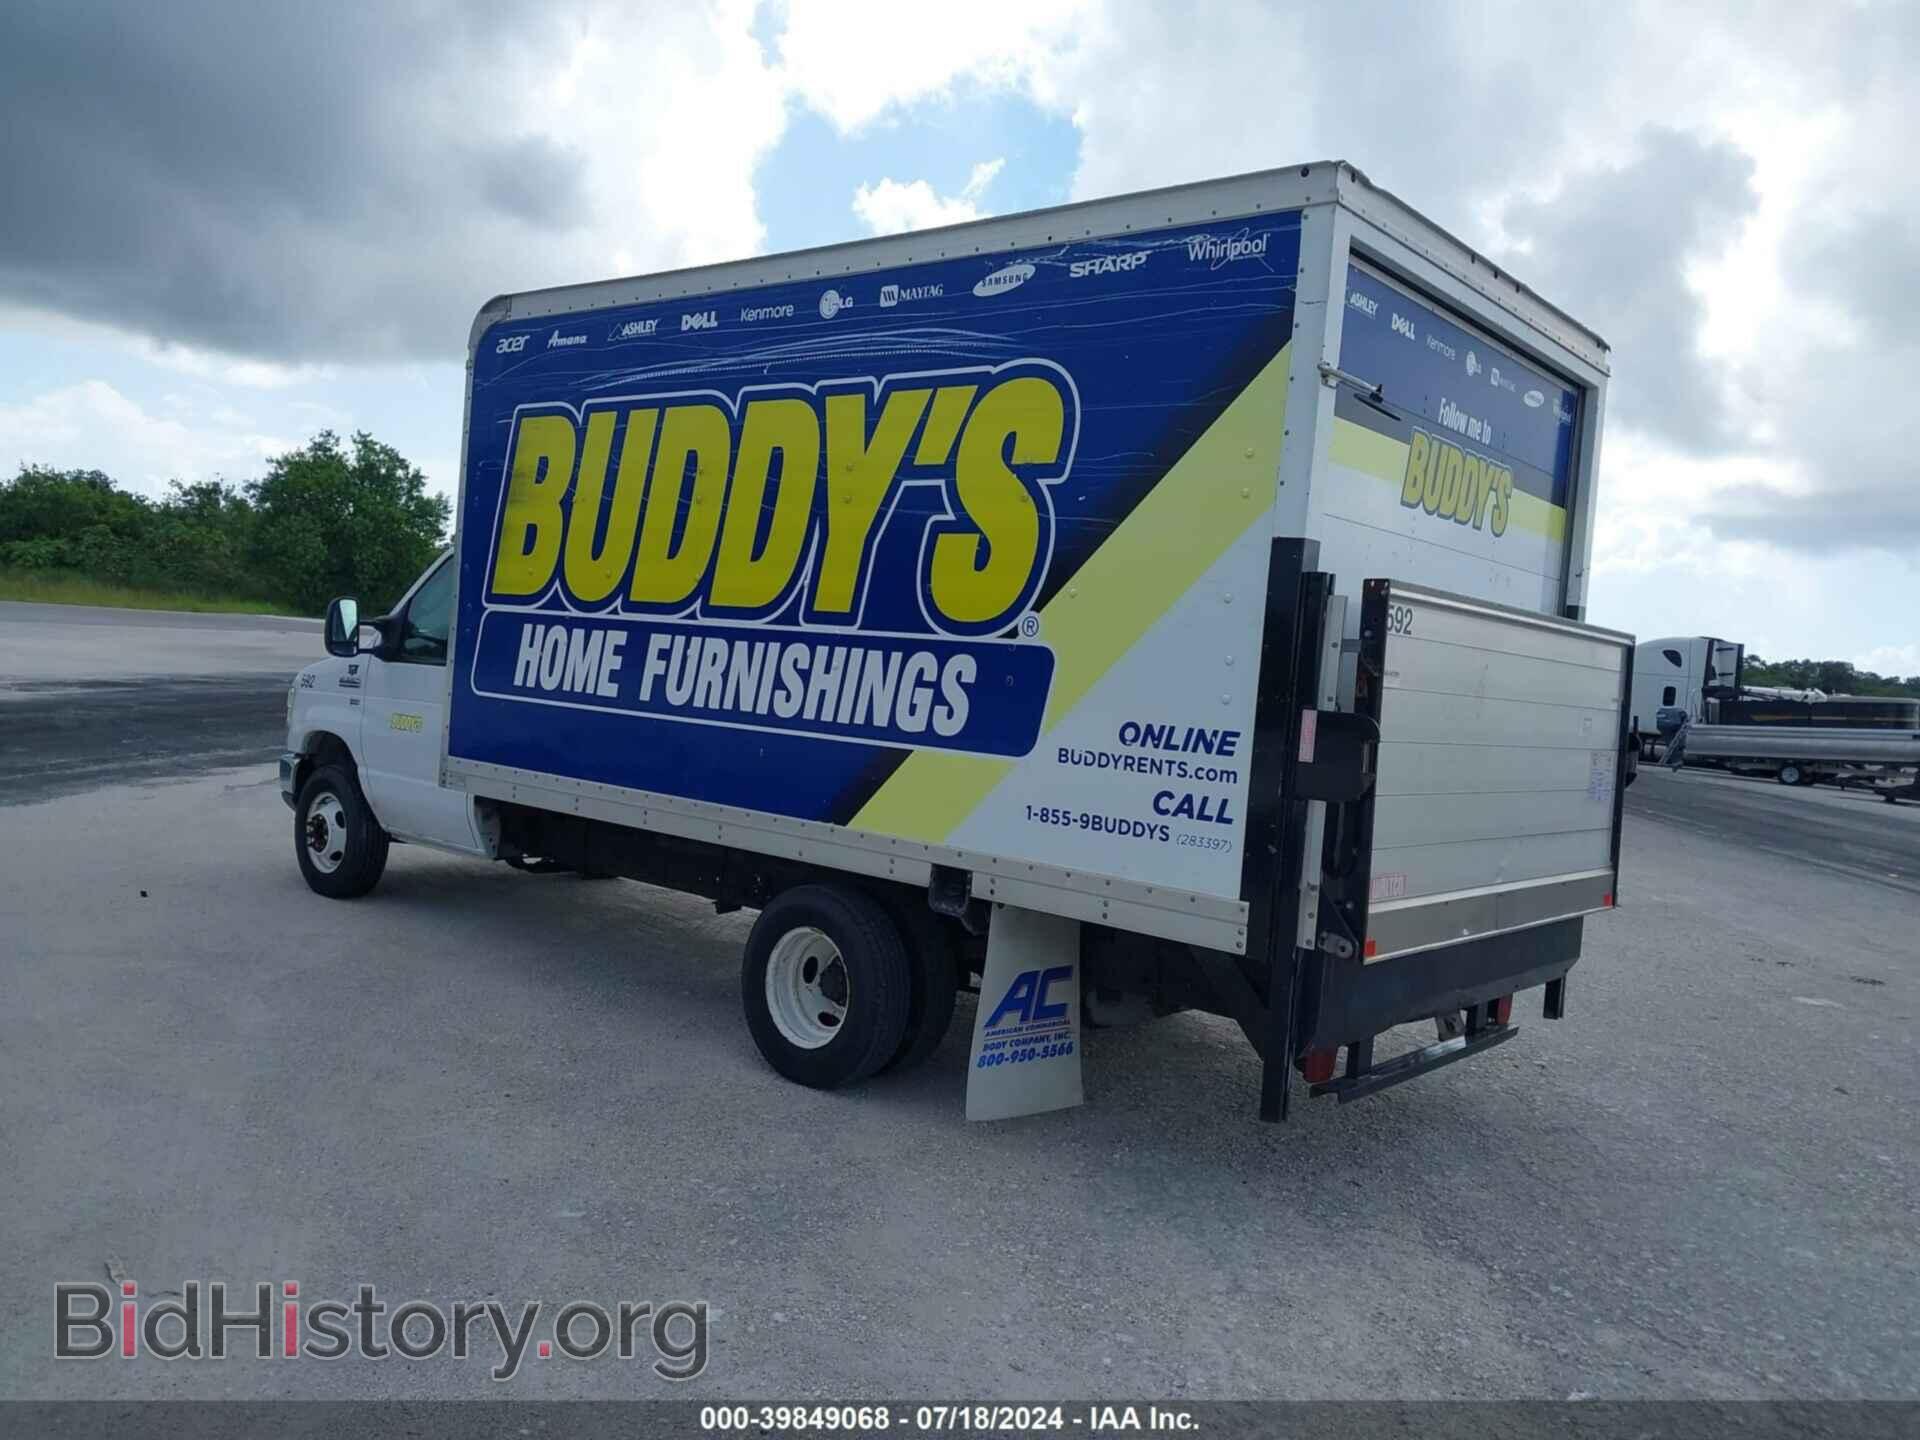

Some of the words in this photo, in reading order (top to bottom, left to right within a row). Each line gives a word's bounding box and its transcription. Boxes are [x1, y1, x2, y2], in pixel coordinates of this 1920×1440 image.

[1188, 234, 1268, 264] Whirlpool
[1070, 251, 1150, 278] SHARP
[899, 284, 943, 302] MAYTAG
[981, 271, 1029, 288] SAMSUNG
[681, 311, 718, 331] DELL
[740, 303, 794, 321] Kenmore
[1391, 312, 1416, 340] DELL
[546, 329, 588, 348] Amana
[621, 319, 658, 337] ASHLEY
[496, 334, 530, 354] acer
[1438, 397, 1469, 434] Follow
[1466, 416, 1482, 441] me
[1481, 418, 1493, 446] to
[1401, 428, 1513, 537] BUDDY'S
[490, 376, 1065, 624] BUDDY'S
[1387, 606, 1412, 635] 592
[513, 623, 628, 699] HOME
[638, 633, 977, 738] FURNISHINGS
[1118, 721, 1241, 757] ONLINE
[1057, 748, 1238, 784] BUDDYRENTS.com
[1152, 790, 1234, 825] CALL
[1025, 805, 1170, 842] 1-855-9BUDDYS
[1175, 833, 1232, 853] (283397)
[984, 965, 1074, 1027] AC
[983, 1040, 1009, 1052] BODY
